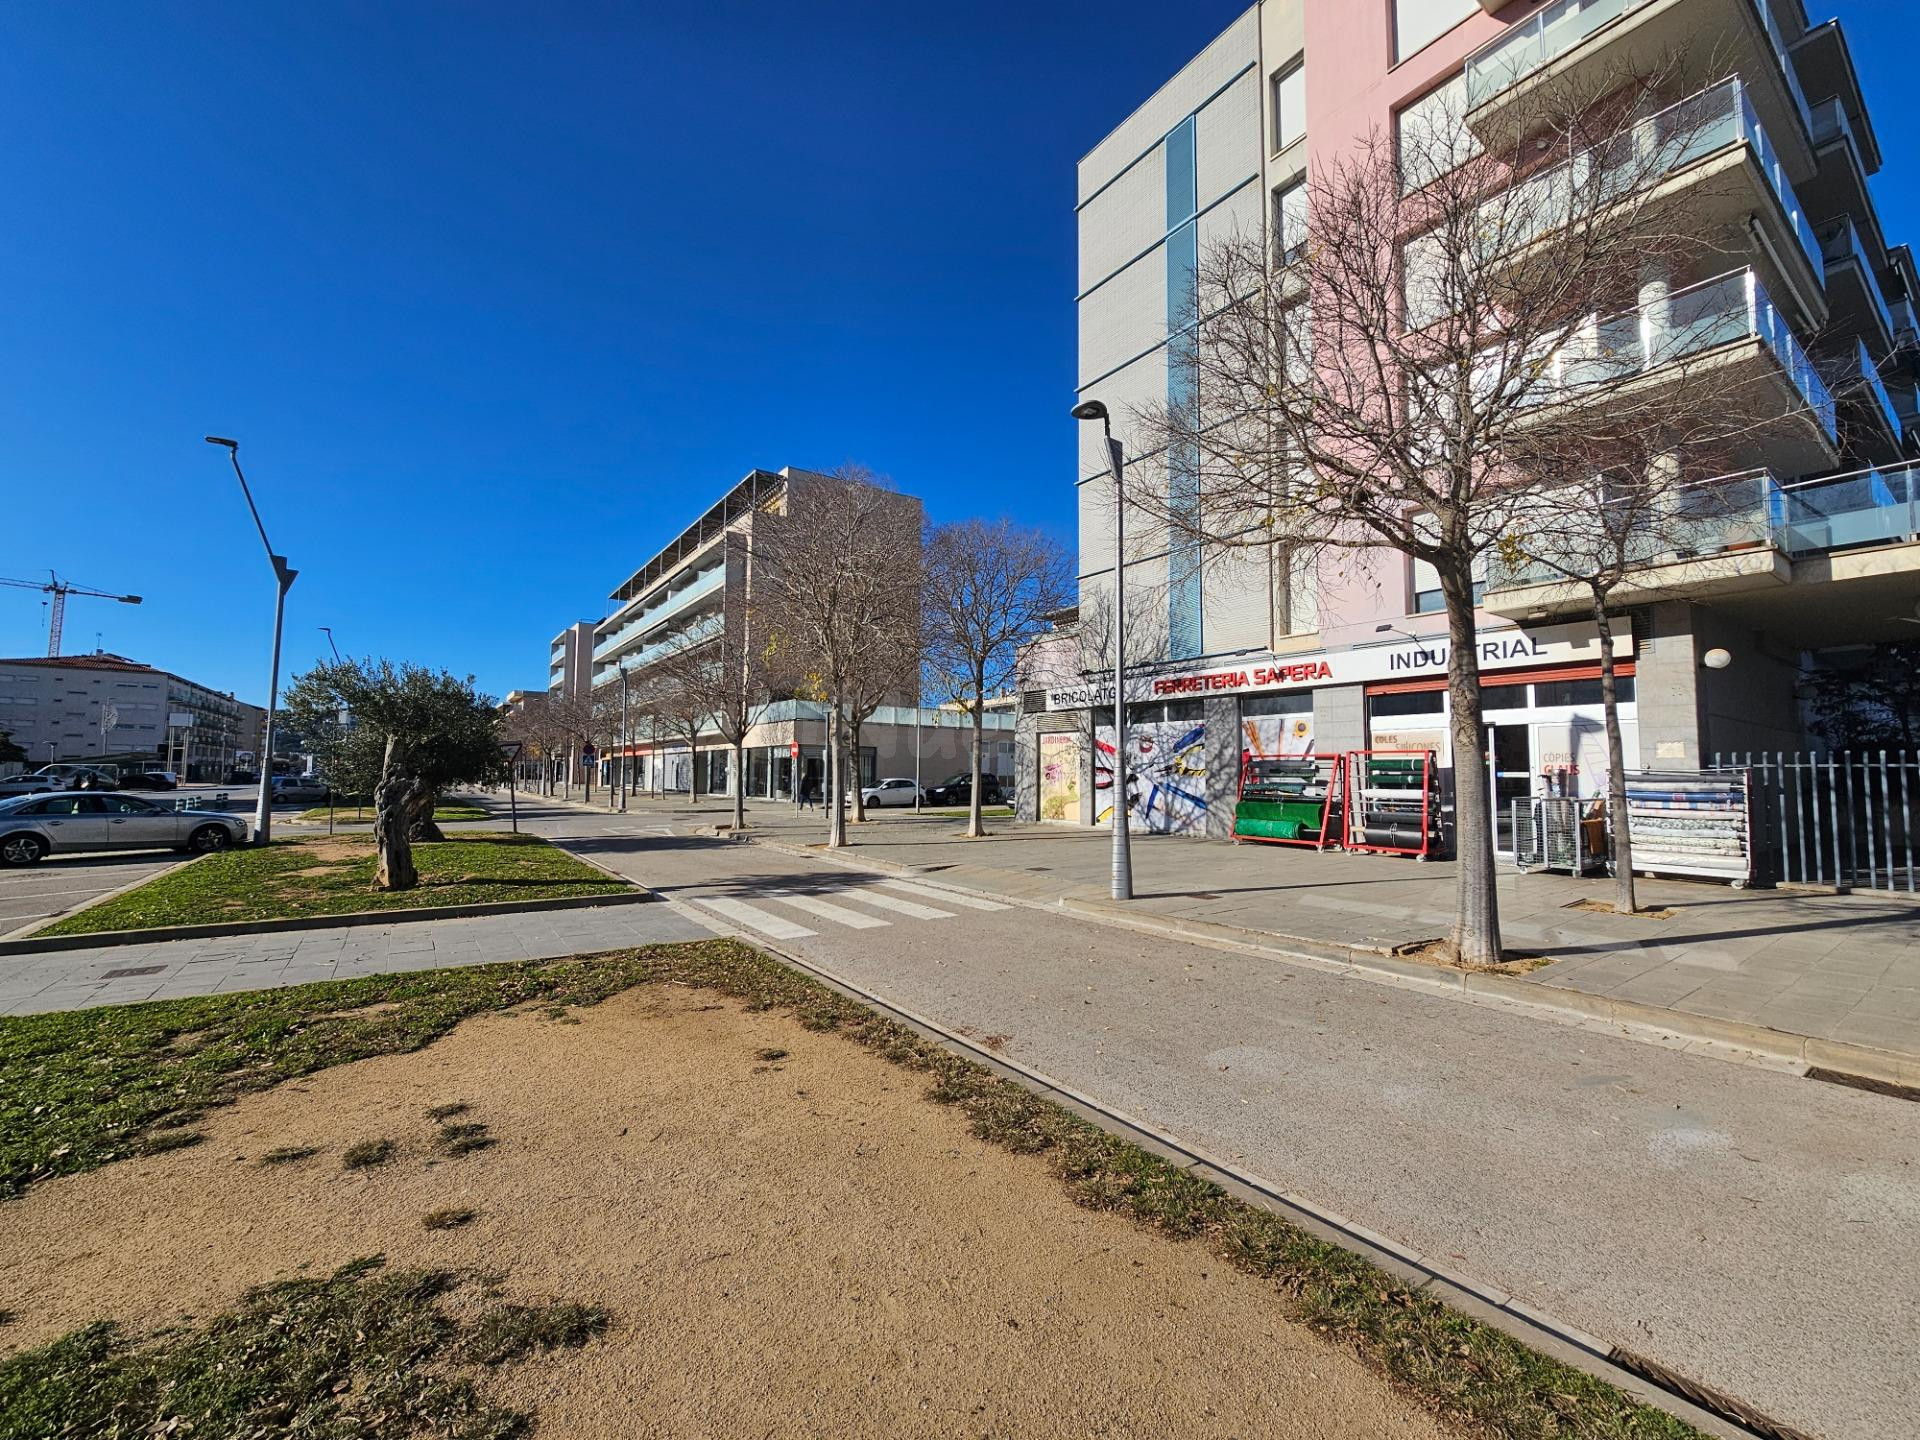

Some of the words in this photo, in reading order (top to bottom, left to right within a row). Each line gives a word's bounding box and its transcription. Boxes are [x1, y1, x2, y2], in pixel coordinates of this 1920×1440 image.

[1390, 637, 1548, 671] INDURIAL
[1154, 671, 1250, 695] FERRETERIA
[1253, 661, 1332, 685] SAPERA
[1054, 687, 1117, 705] BRICOLATG
